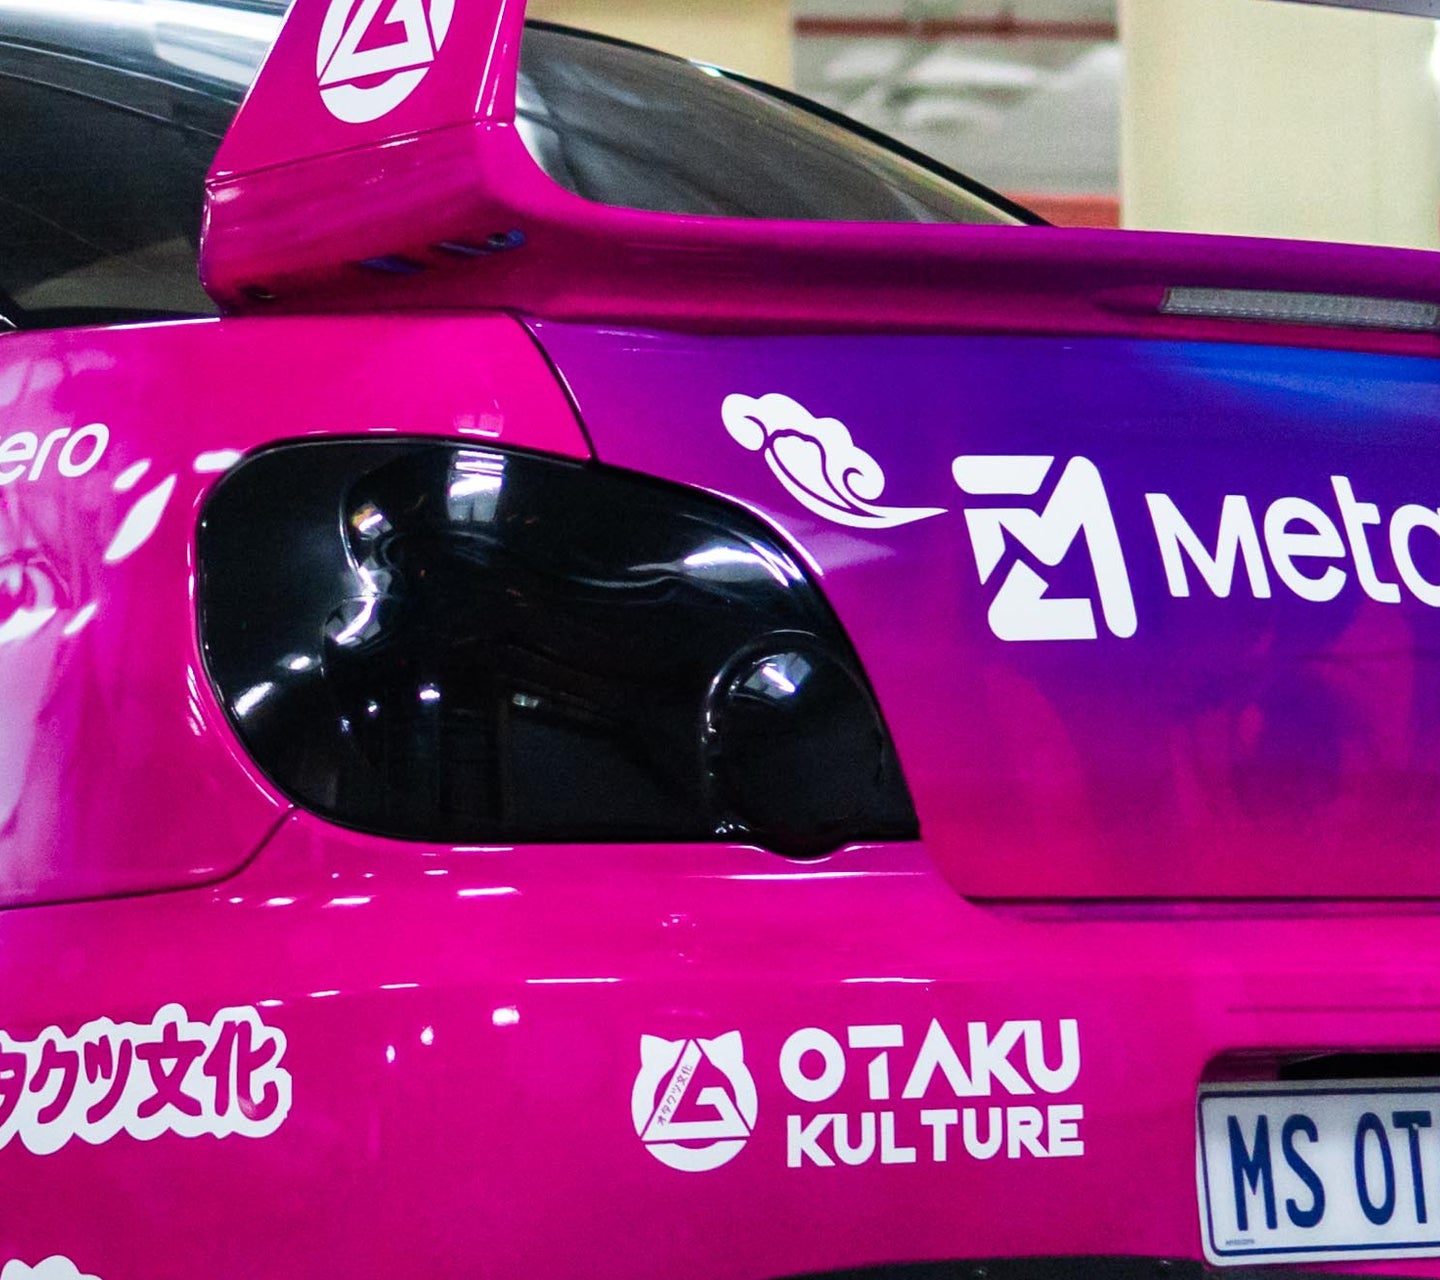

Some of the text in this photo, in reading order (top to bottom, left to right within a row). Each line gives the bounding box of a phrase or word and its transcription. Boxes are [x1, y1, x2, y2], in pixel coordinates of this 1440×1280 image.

[778, 1018, 1081, 1102] OTAKU
[786, 1104, 1085, 1168] KULTURE
[1227, 1112, 1324, 1231] MS
